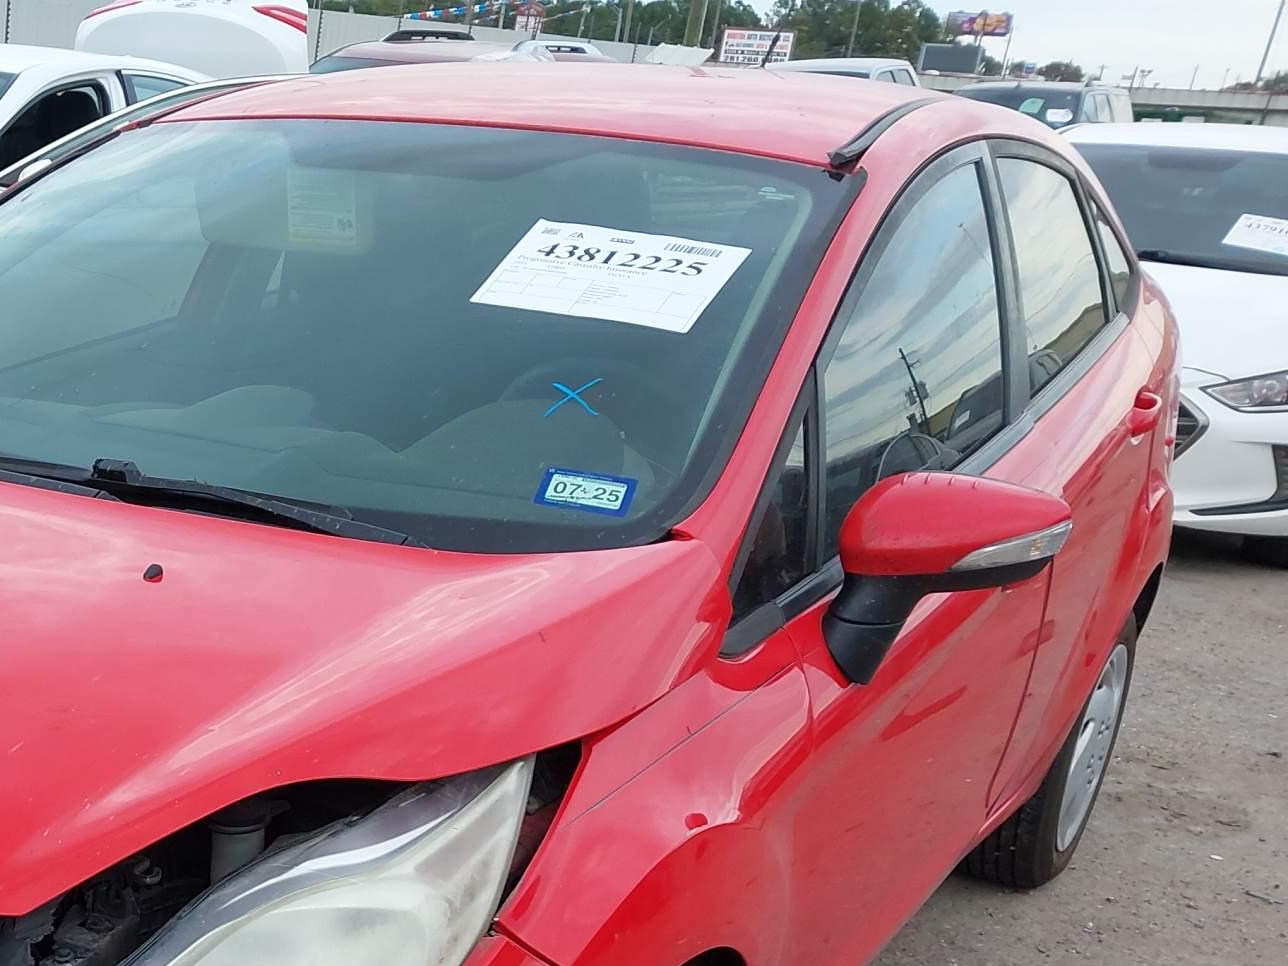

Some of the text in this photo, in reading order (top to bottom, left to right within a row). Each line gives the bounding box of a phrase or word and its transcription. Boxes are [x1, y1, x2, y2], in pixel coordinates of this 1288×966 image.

[537, 242, 710, 278] 43812225
[553, 481, 583, 496] 07
[591, 487, 622, 503] 25
